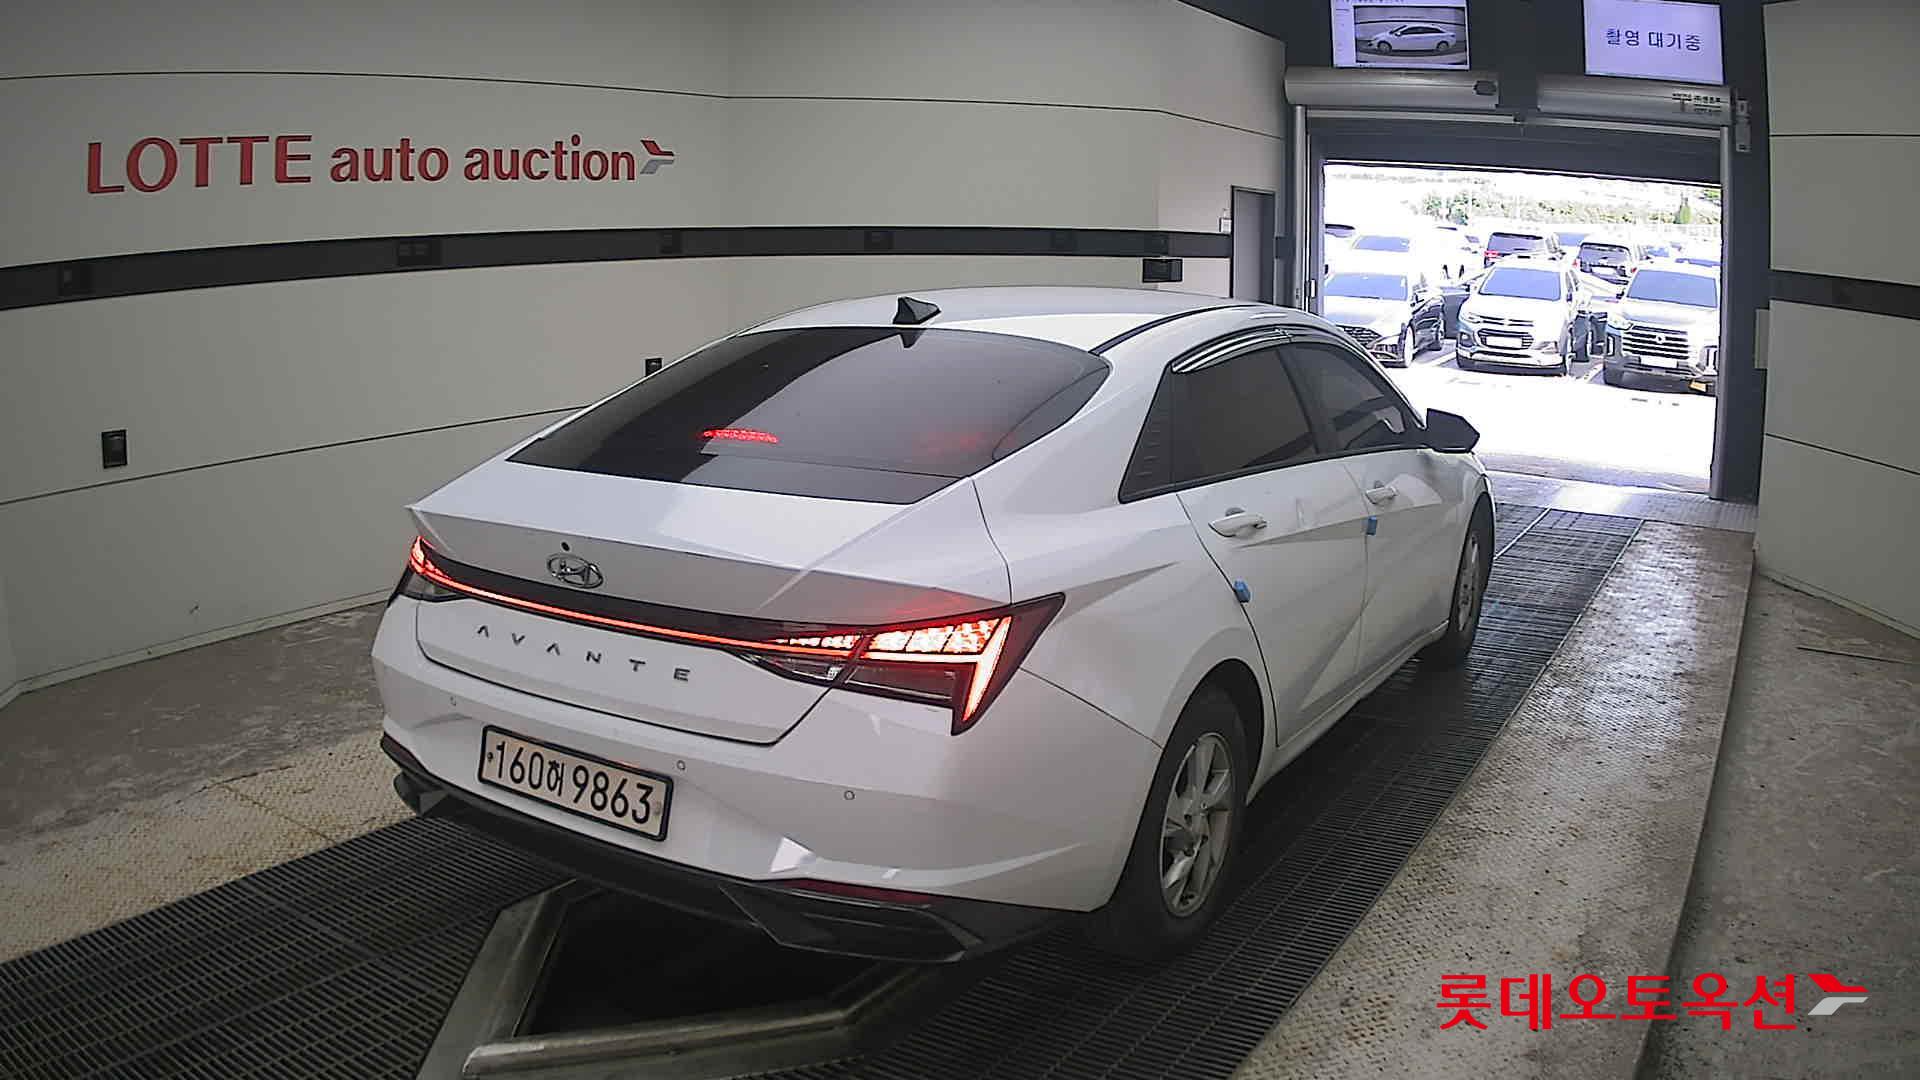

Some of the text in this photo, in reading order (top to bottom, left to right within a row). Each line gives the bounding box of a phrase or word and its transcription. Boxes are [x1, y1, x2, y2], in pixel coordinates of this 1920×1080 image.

[1648, 31, 1701, 52] 대기중
[87, 134, 637, 194] LOTTE auto auction
[477, 624, 691, 682] AVANTE
